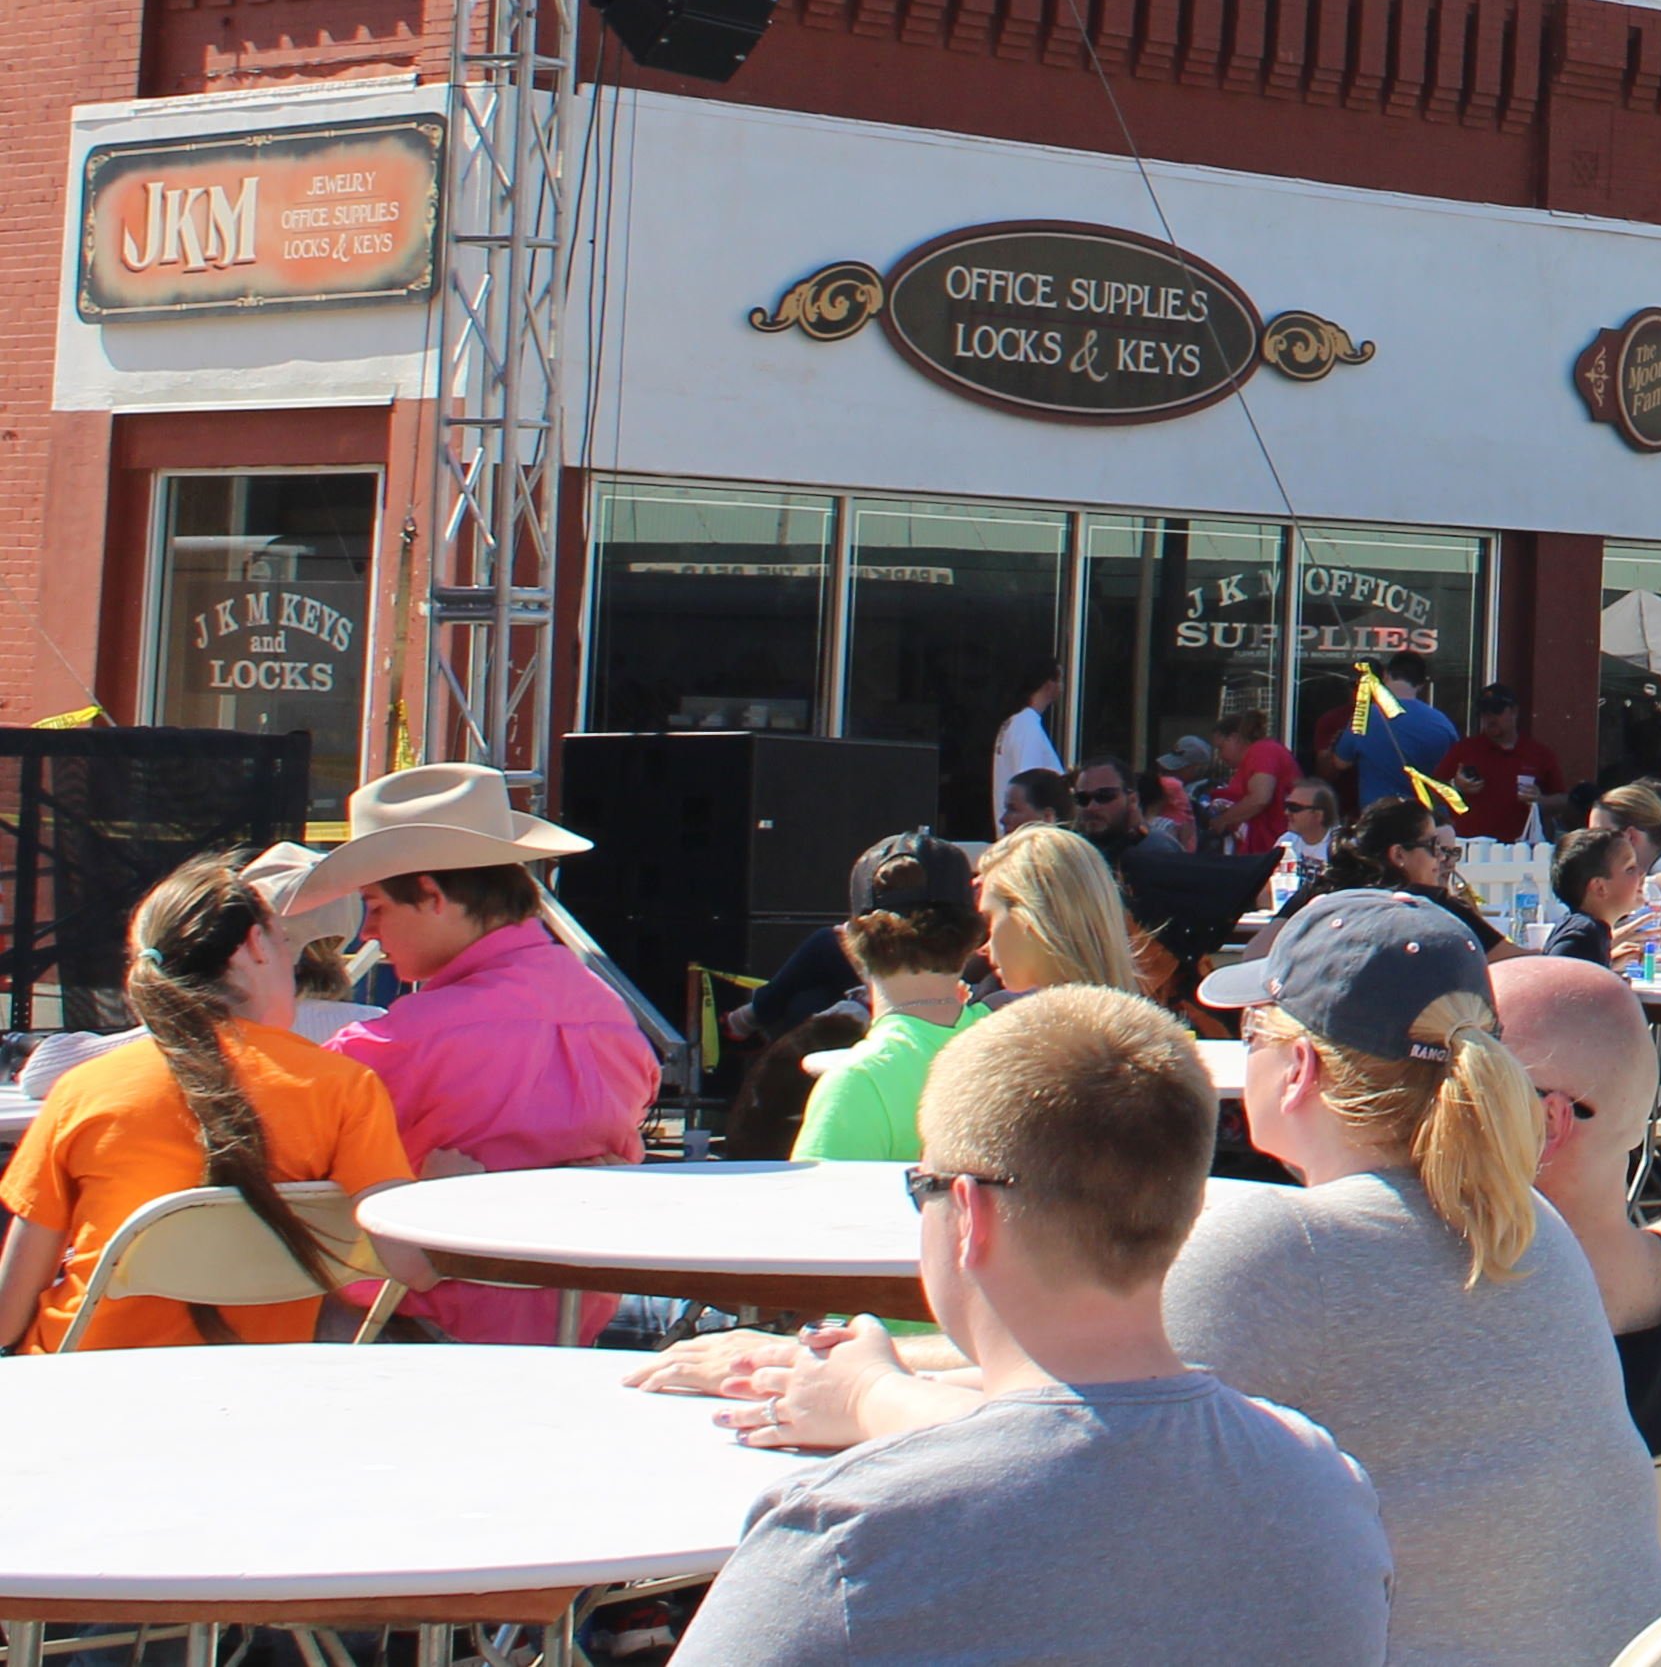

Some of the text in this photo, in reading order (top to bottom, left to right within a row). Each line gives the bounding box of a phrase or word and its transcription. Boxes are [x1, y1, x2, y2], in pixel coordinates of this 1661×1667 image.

[307, 171, 378, 197] JEWELRY
[121, 176, 260, 273] JKM
[281, 201, 400, 230] OFFICE SUPPLIES
[284, 233, 394, 263] LOCKS & KEYS
[946, 264, 1209, 324] OFFICE SUPPLIES
[955, 322, 1202, 382] LOCKS & KEYS
[1636, 343, 1657, 364] The
[1187, 587, 1204, 619] J
[1217, 574, 1248, 607] K
[1304, 567, 1432, 625] OFFICE
[195, 591, 354, 653] J K M KEYS
[1176, 620, 1440, 654] SUPPLIES
[250, 630, 287, 653] and
[209, 659, 335, 693] LOCKS
